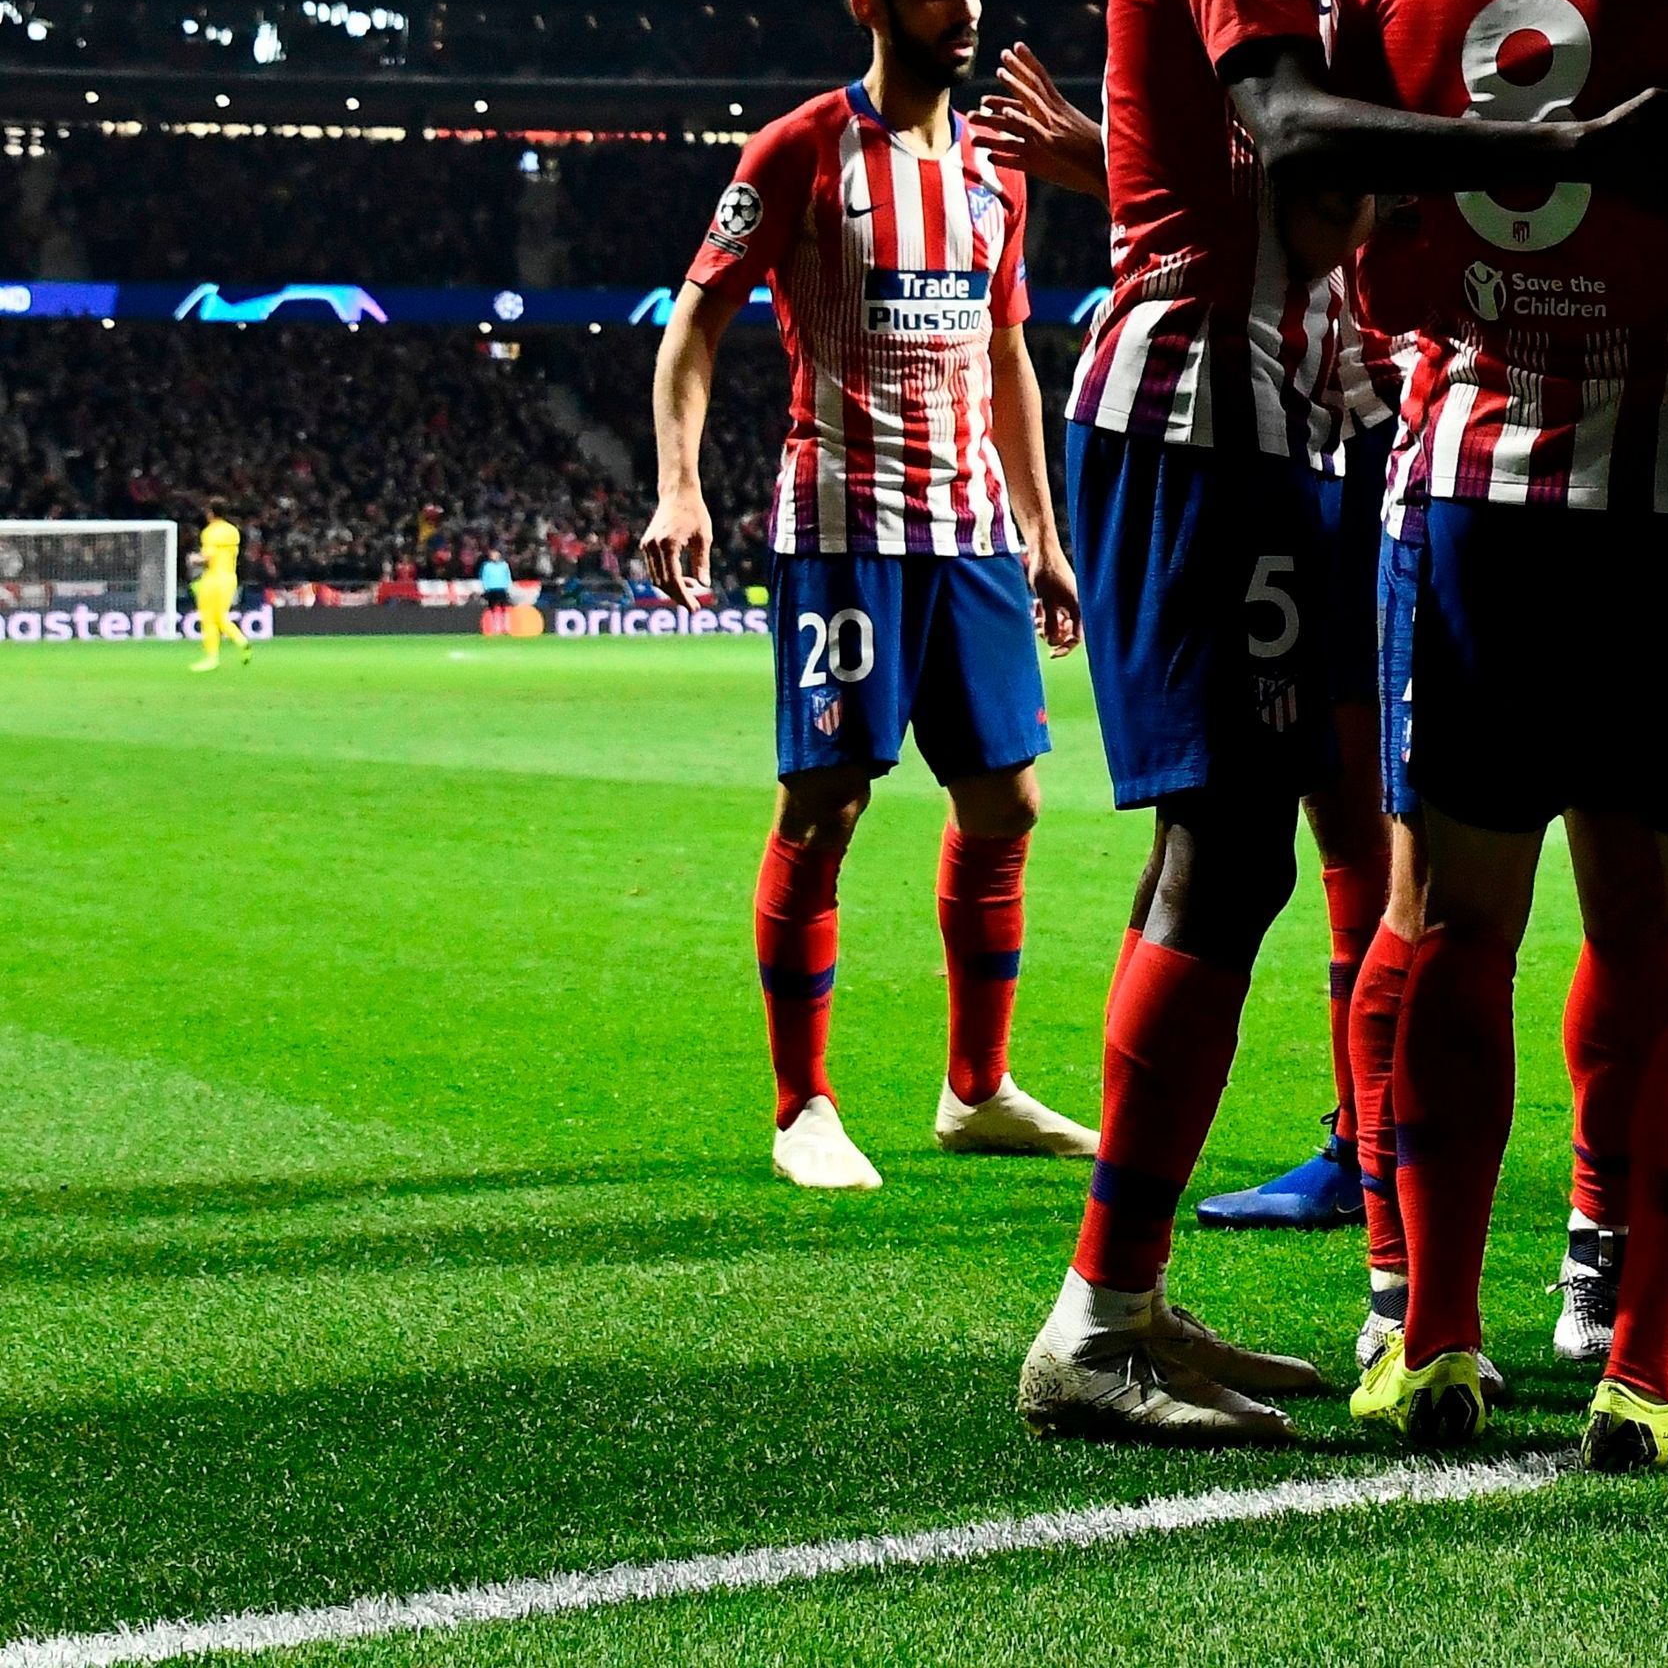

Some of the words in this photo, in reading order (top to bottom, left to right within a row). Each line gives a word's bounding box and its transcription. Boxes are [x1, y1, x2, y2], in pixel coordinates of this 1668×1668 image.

[898, 272, 971, 300] Trade
[1511, 272, 1564, 292] Save
[1570, 275, 1607, 294] the
[868, 307, 983, 332] Plus500
[1513, 296, 1607, 317] Children
[554, 604, 770, 636] priceless
[1244, 555, 1300, 659] 5
[798, 607, 875, 688] 20
